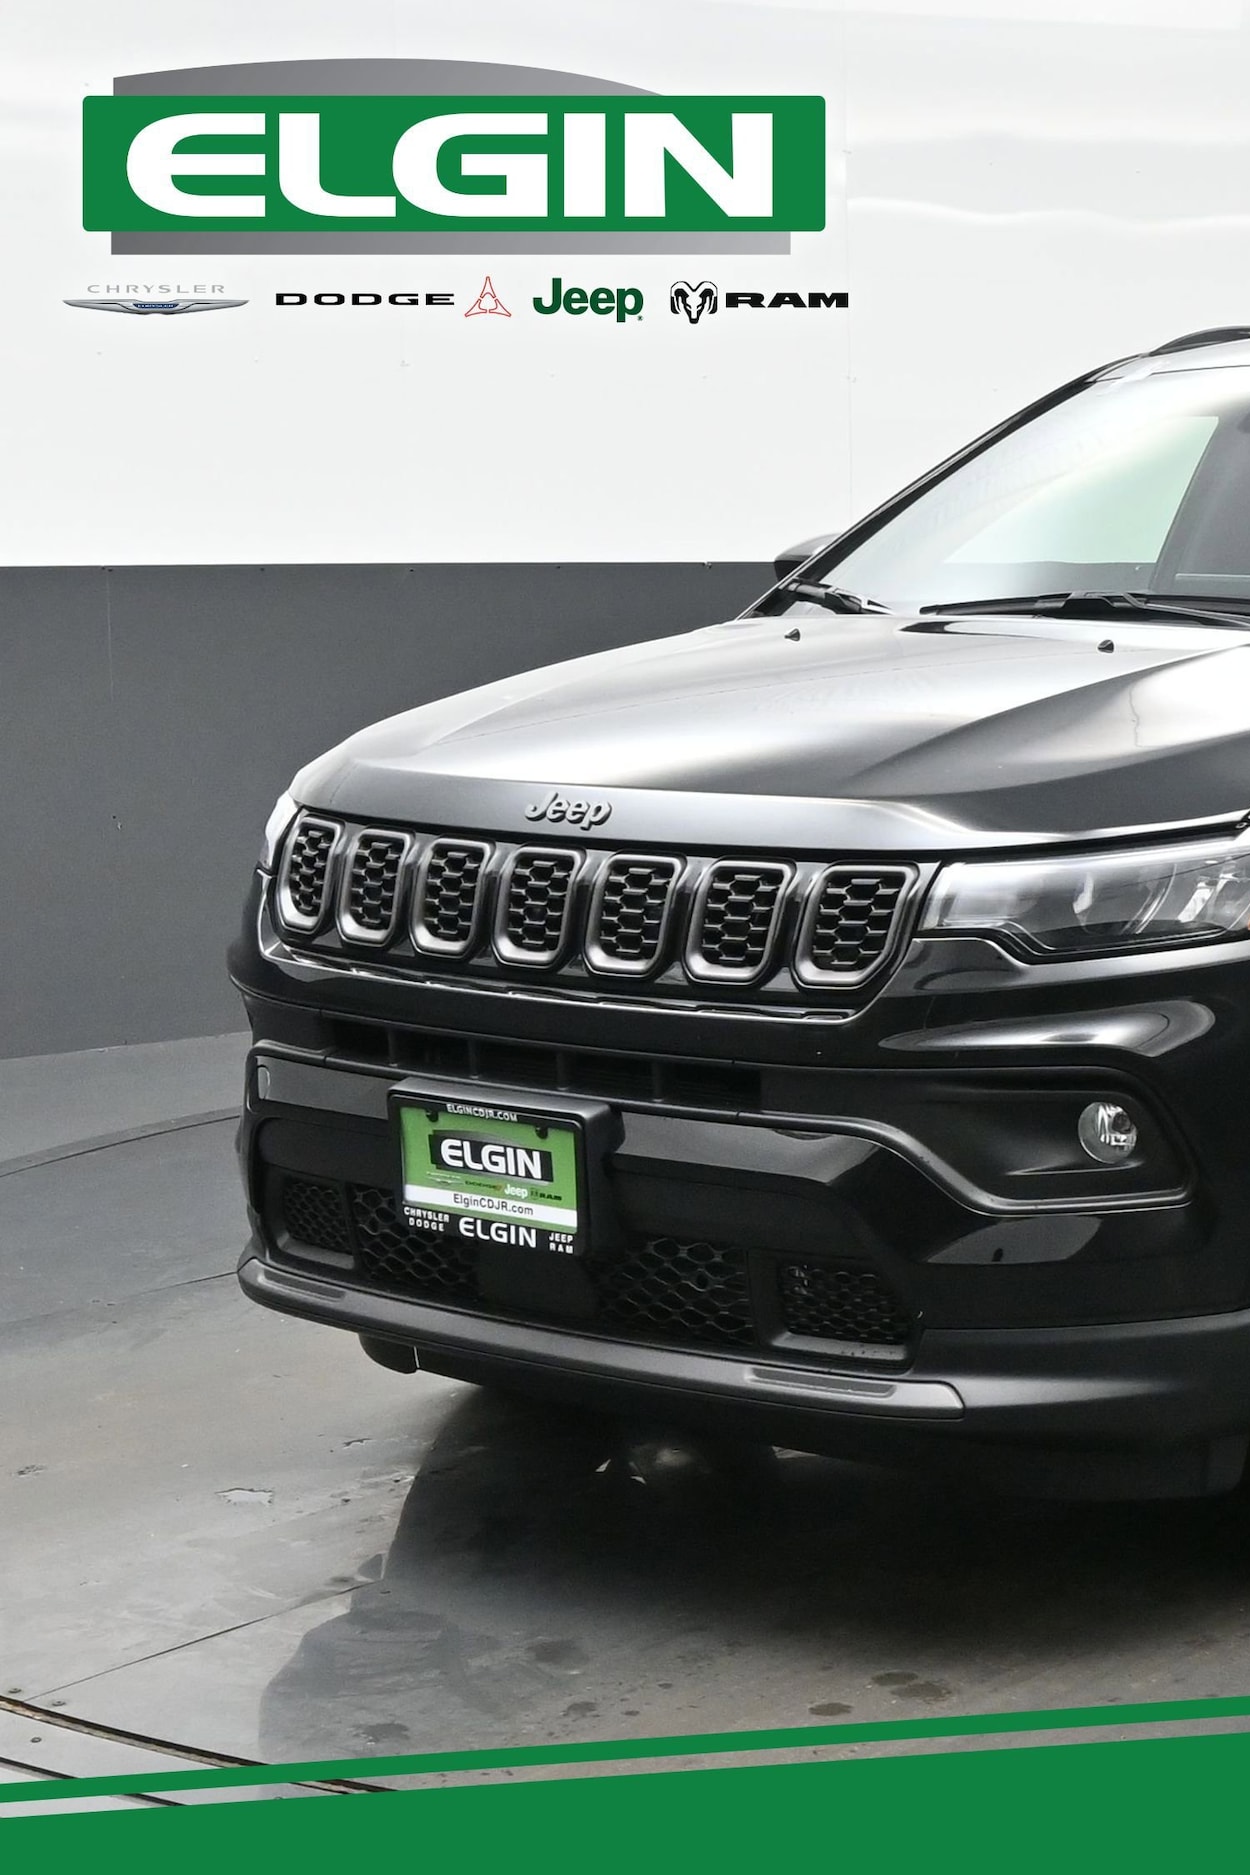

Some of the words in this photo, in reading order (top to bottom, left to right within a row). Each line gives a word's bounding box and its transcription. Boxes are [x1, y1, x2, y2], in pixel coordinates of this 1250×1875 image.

[524, 791, 613, 831] Jeep
[446, 1103, 518, 1122] ELGINCDJR.COM
[440, 1138, 542, 1180] ELGIN
[504, 1184, 529, 1199] Jeep
[453, 1193, 534, 1216] ElginCDJR.com
[404, 1206, 450, 1223] CHRYSLER
[408, 1217, 445, 1232] DODGE
[458, 1217, 537, 1248] ELGIN
[549, 1232, 574, 1244] JEEP
[549, 1242, 574, 1255] RAM
